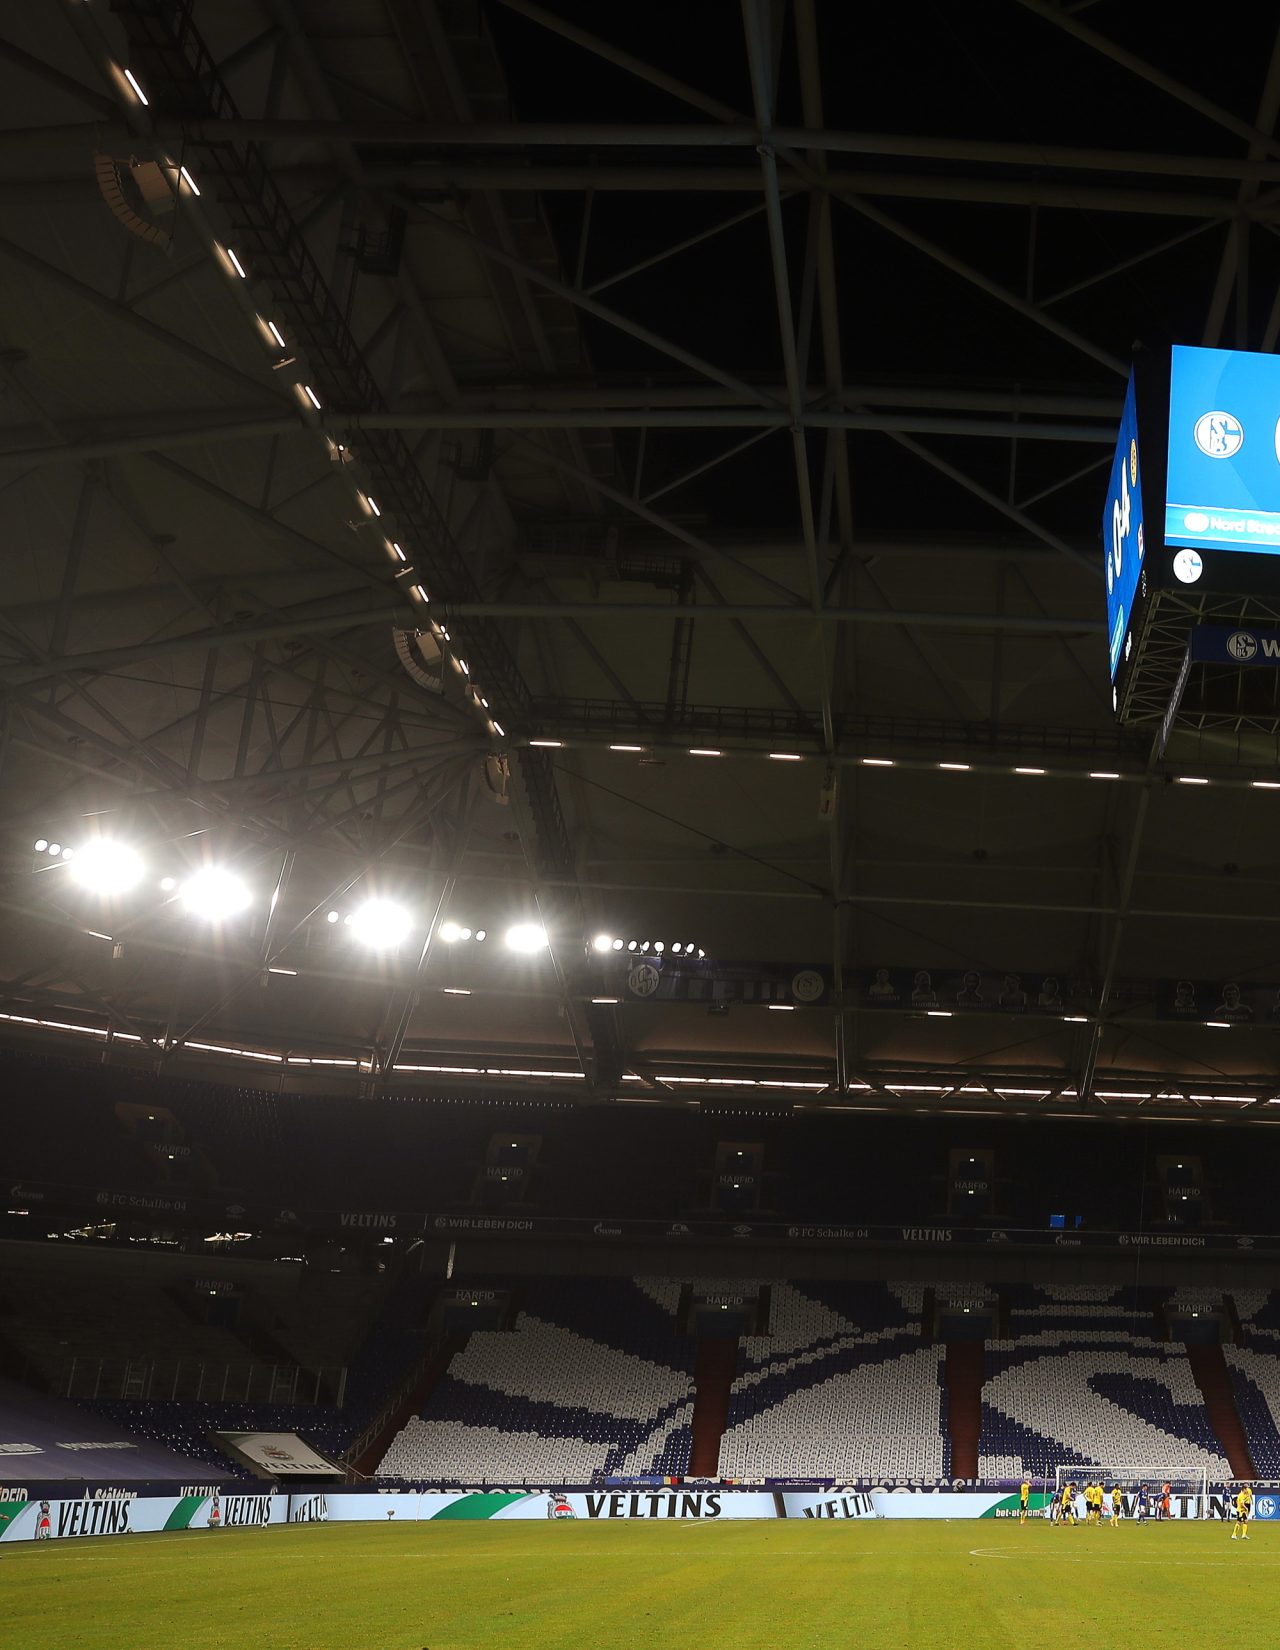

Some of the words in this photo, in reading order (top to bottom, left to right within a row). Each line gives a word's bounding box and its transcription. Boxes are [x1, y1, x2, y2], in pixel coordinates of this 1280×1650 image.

[1210, 517, 1245, 533] Nord
[129, 1196, 171, 1209] Schalke
[173, 1200, 188, 1211] 04
[340, 1213, 397, 1227] VELTINS
[449, 1218, 471, 1229] WIR
[472, 1219, 505, 1229] LEBEN
[507, 1220, 533, 1230] DICH
[802, 1227, 817, 1237] FC
[819, 1228, 854, 1238] Schalke
[856, 1229, 869, 1238] 04
[902, 1228, 953, 1242] VELTINS
[1131, 1236, 1150, 1246] WIR
[1151, 1236, 1180, 1246] LEBEN
[1181, 1236, 1205, 1247] DICH
[456, 1290, 495, 1301] HARFID
[706, 1296, 744, 1306] HARFID
[949, 1300, 985, 1310] HARFID
[1178, 1304, 1213, 1313] HARFID
[260, 1462, 332, 1470] VELTINS
[180, 1486, 221, 1497] VELTINS
[224, 1496, 272, 1526] VELTINS
[585, 1494, 722, 1518] VELTINS
[57, 1500, 131, 1536] VELTINS
